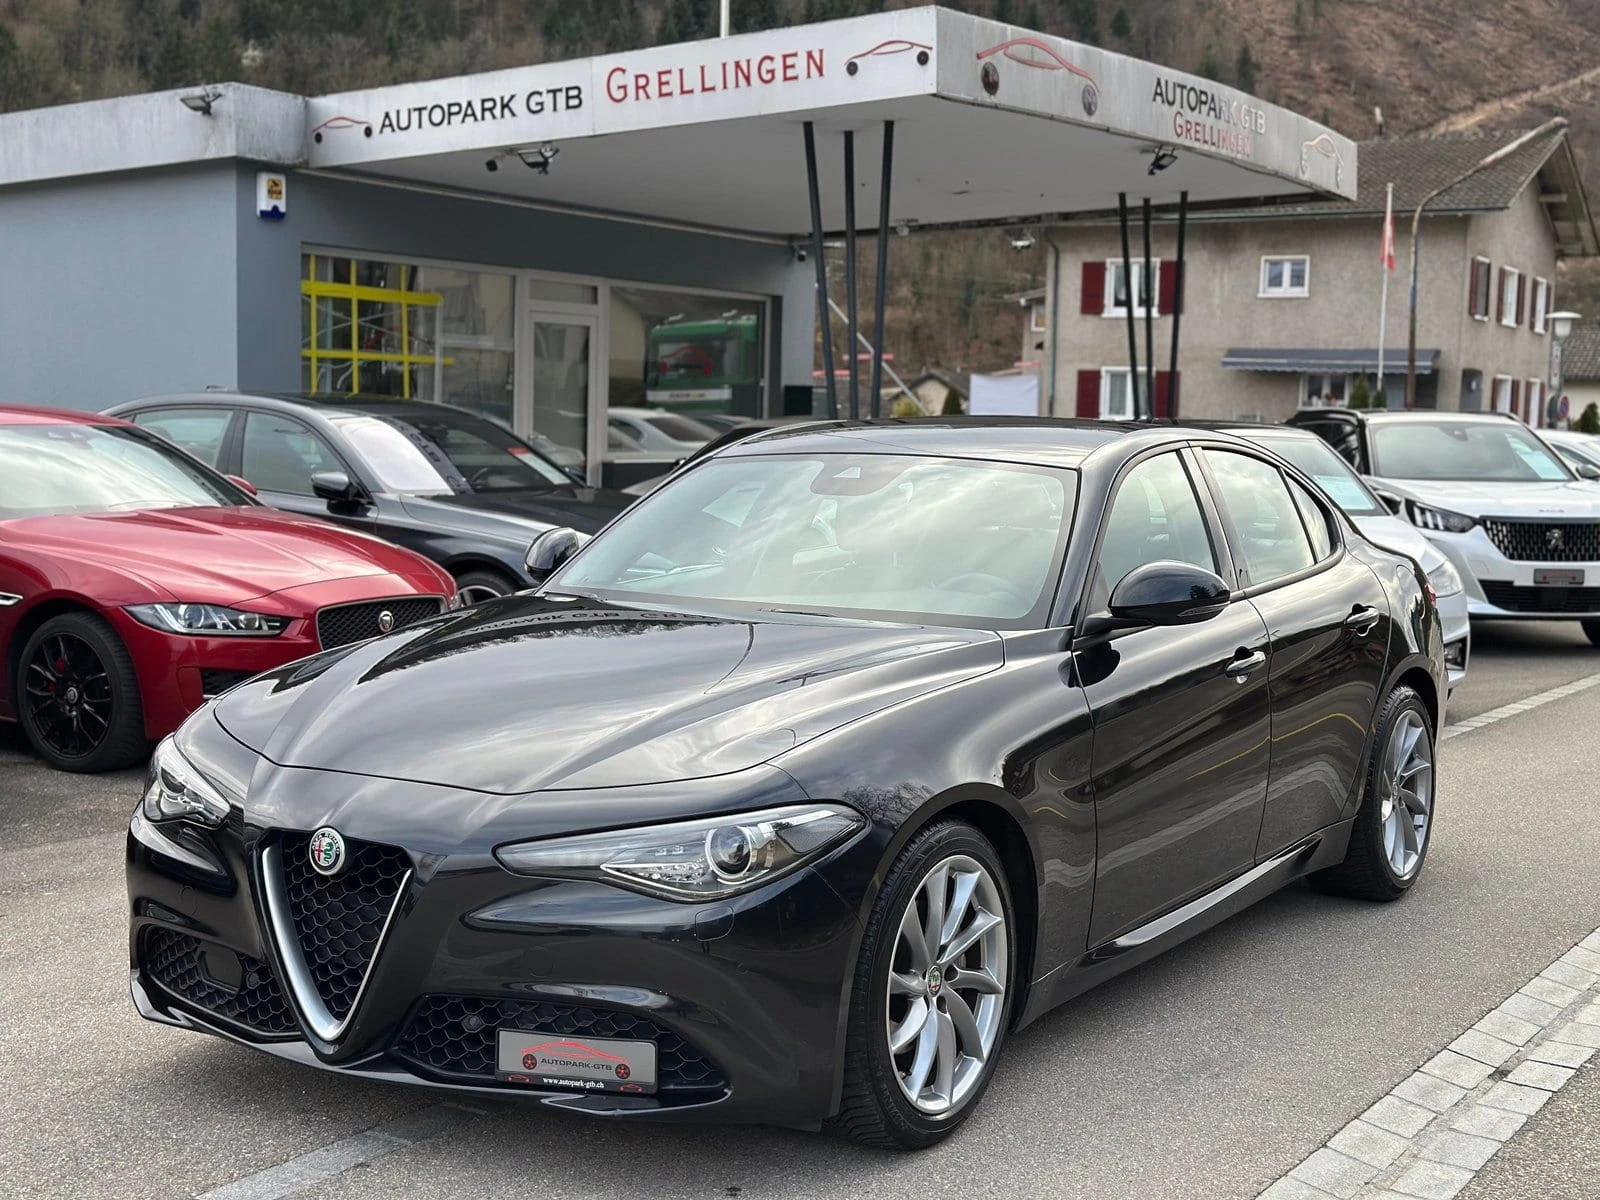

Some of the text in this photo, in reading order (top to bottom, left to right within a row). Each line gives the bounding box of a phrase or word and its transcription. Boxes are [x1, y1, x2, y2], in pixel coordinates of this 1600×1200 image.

[606, 48, 825, 103] GRELLINGEN
[379, 85, 583, 134] AUTOPARK GTB
[1152, 77, 1266, 134] AUTOPARK GTB
[1173, 111, 1251, 157] GRELLINGEN
[541, 1058, 612, 1071] AUTOPARK-GTB
[542, 1078, 604, 1089] www.autopark-gtb.ch
